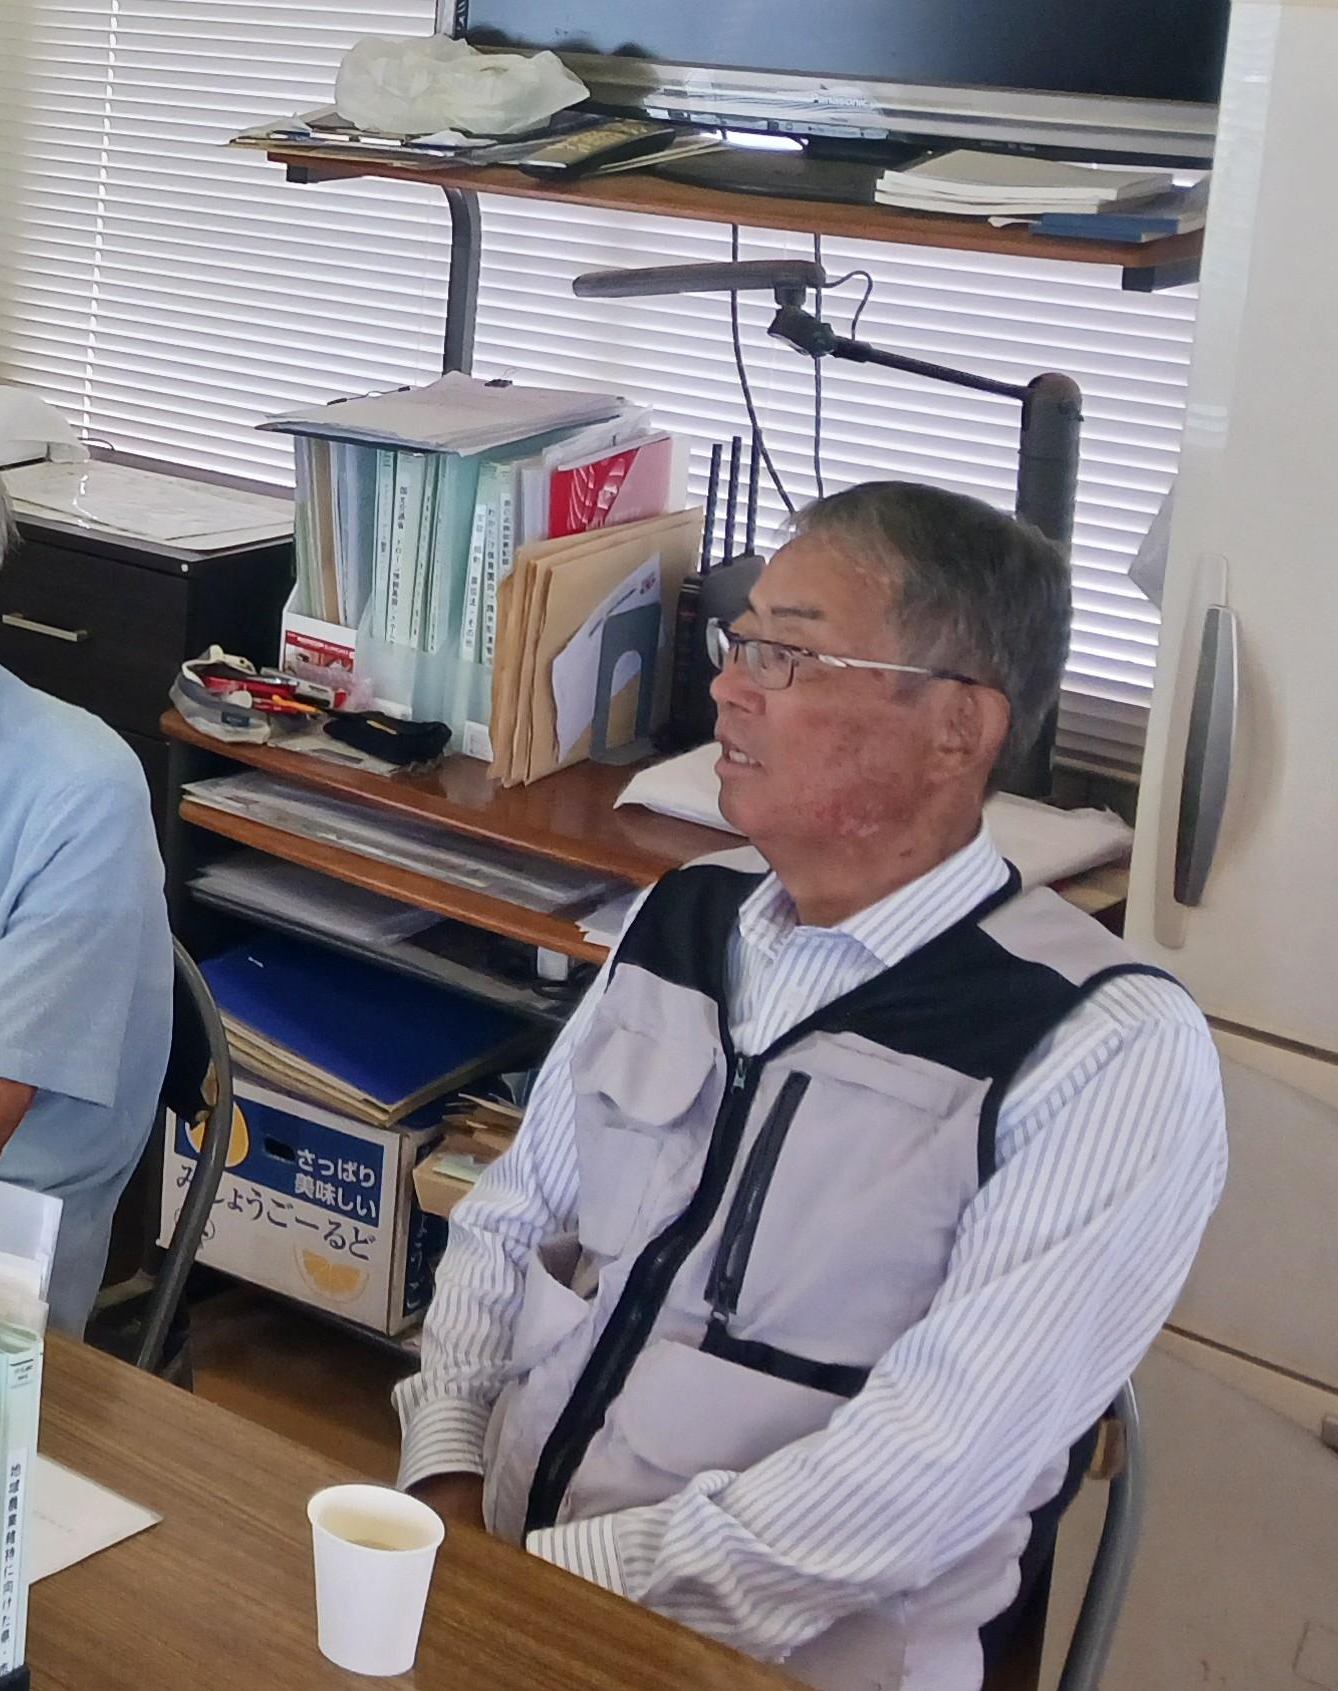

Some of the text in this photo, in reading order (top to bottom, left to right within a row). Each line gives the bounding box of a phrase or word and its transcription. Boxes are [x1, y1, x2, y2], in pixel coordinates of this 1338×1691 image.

[296, 1149, 375, 1188] さっぱり
[176, 1164, 376, 1261] みょうごーるど
[293, 1172, 376, 1218] 美味しい
